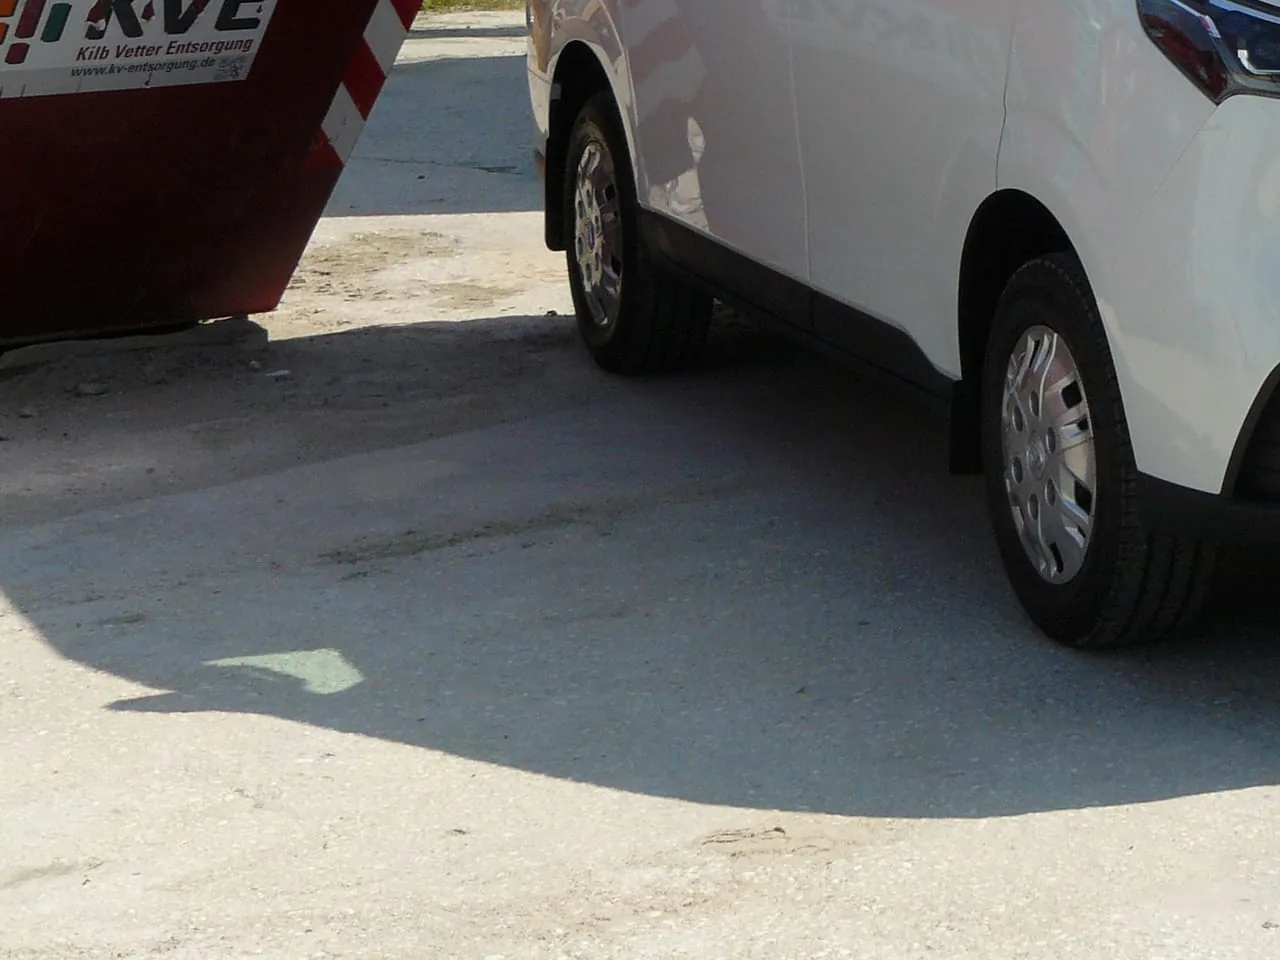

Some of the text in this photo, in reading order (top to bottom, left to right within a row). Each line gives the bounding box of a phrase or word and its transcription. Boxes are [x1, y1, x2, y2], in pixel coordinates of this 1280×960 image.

[76, 38, 254, 62] Kilb Vetter Entsorgung
[71, 56, 217, 77] www.kv-entsorgung.de
